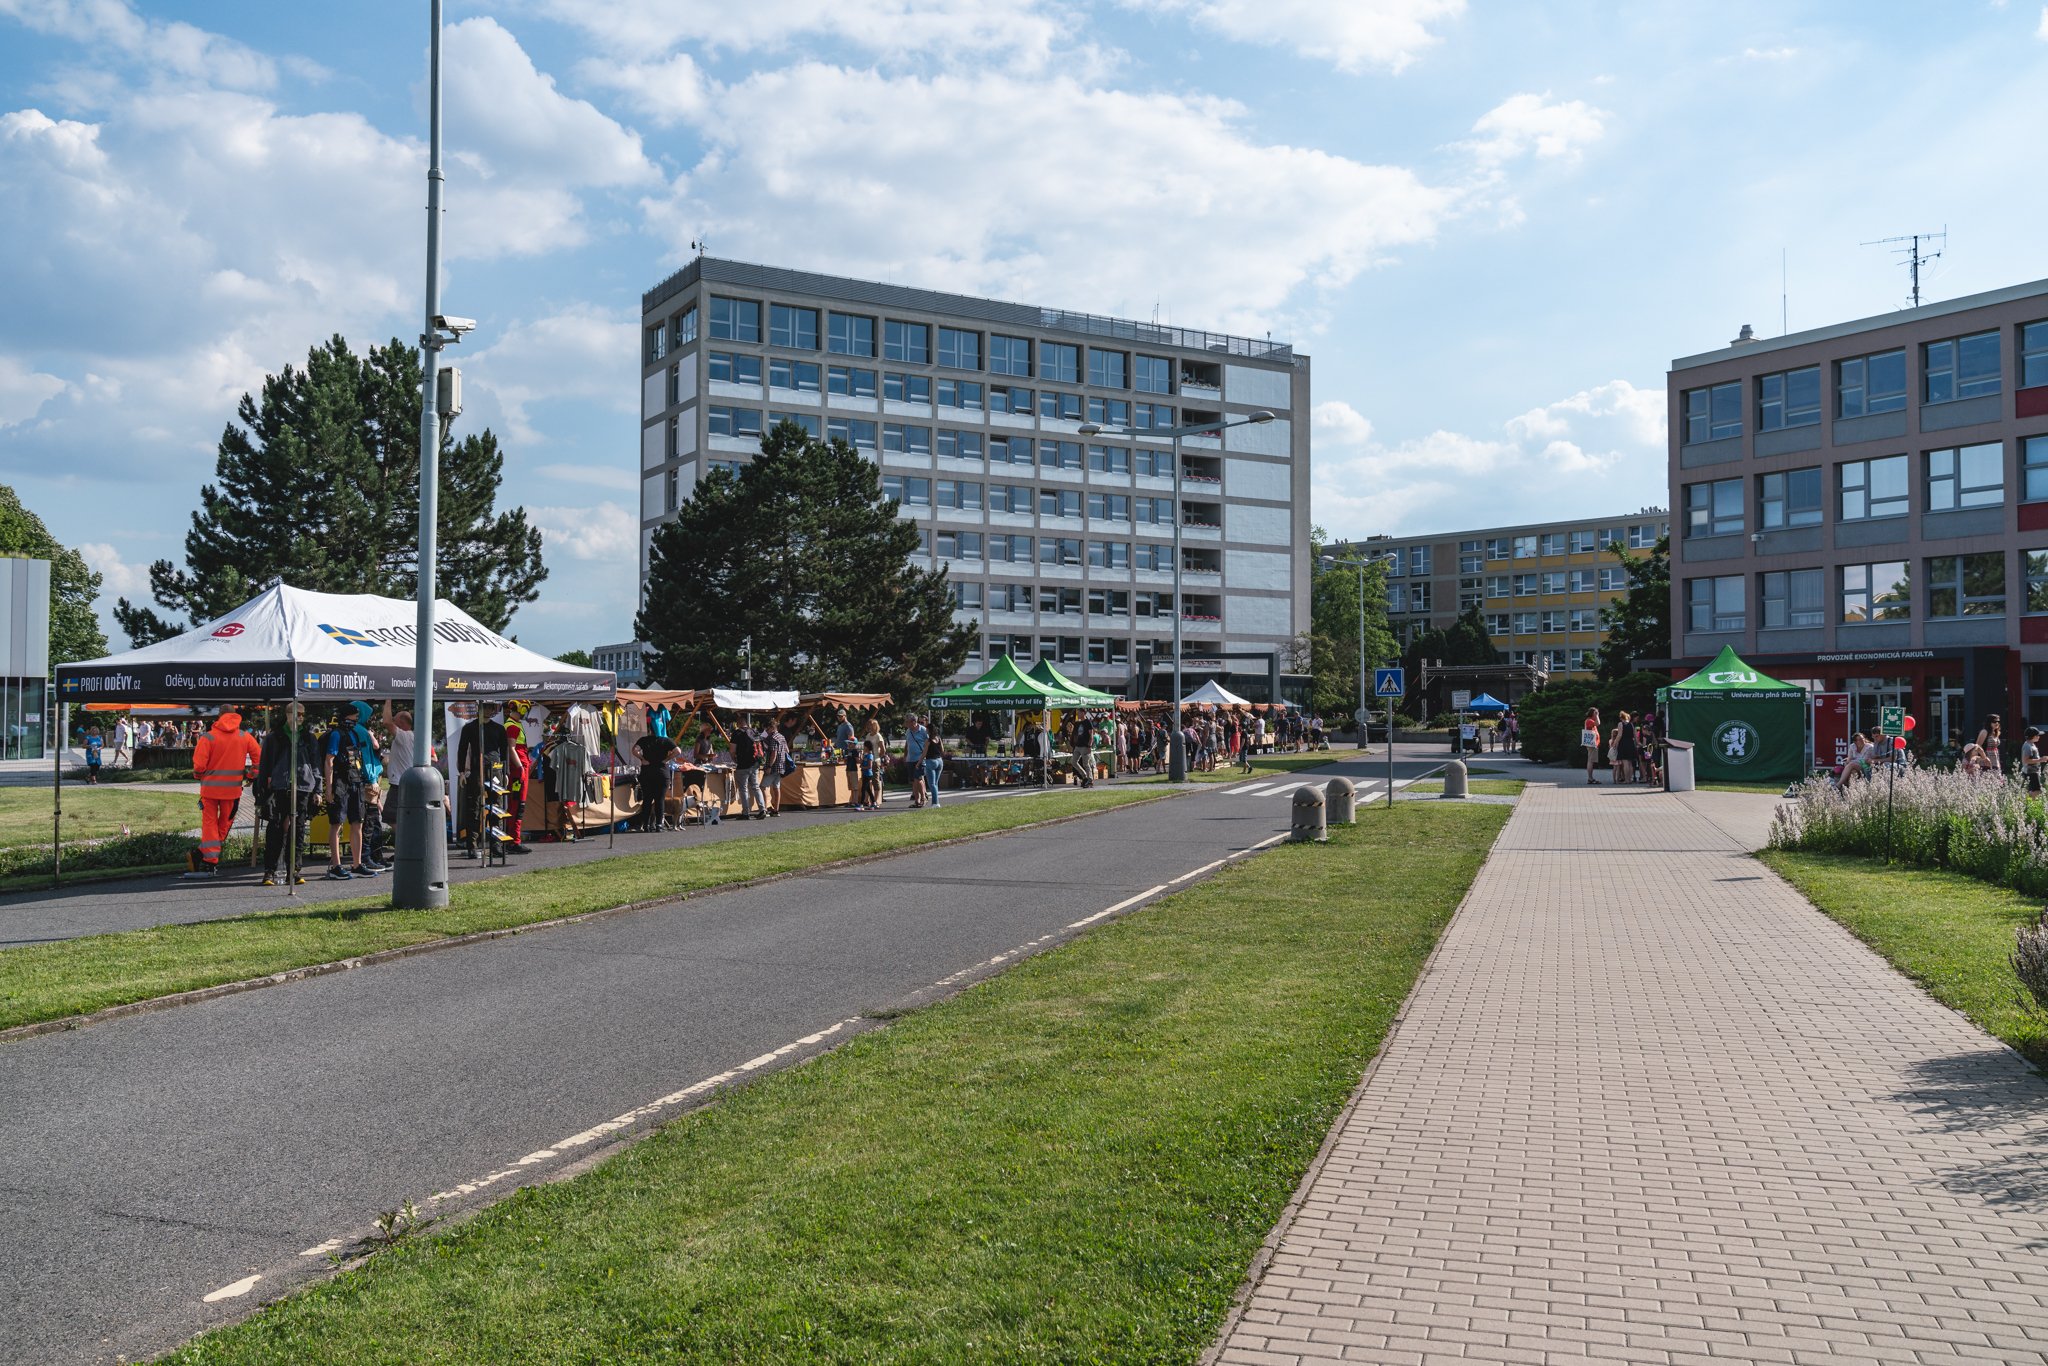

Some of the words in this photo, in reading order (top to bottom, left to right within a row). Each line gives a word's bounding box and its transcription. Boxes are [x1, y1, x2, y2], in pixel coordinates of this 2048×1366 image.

[1854, 651, 1900, 660] EKONOMICKÁ
[1901, 650, 1934, 658] FAKULTA
[80, 676, 103, 692] PROFI
[165, 674, 196, 690] Oděvy,
[198, 674, 221, 687] obuv
[223, 677, 229, 687] a
[231, 674, 254, 687] ruční
[255, 673, 286, 687] nářadí
[321, 673, 342, 689] PROFI
[1765, 691, 1780, 699] plná
[986, 698, 1014, 707] University
